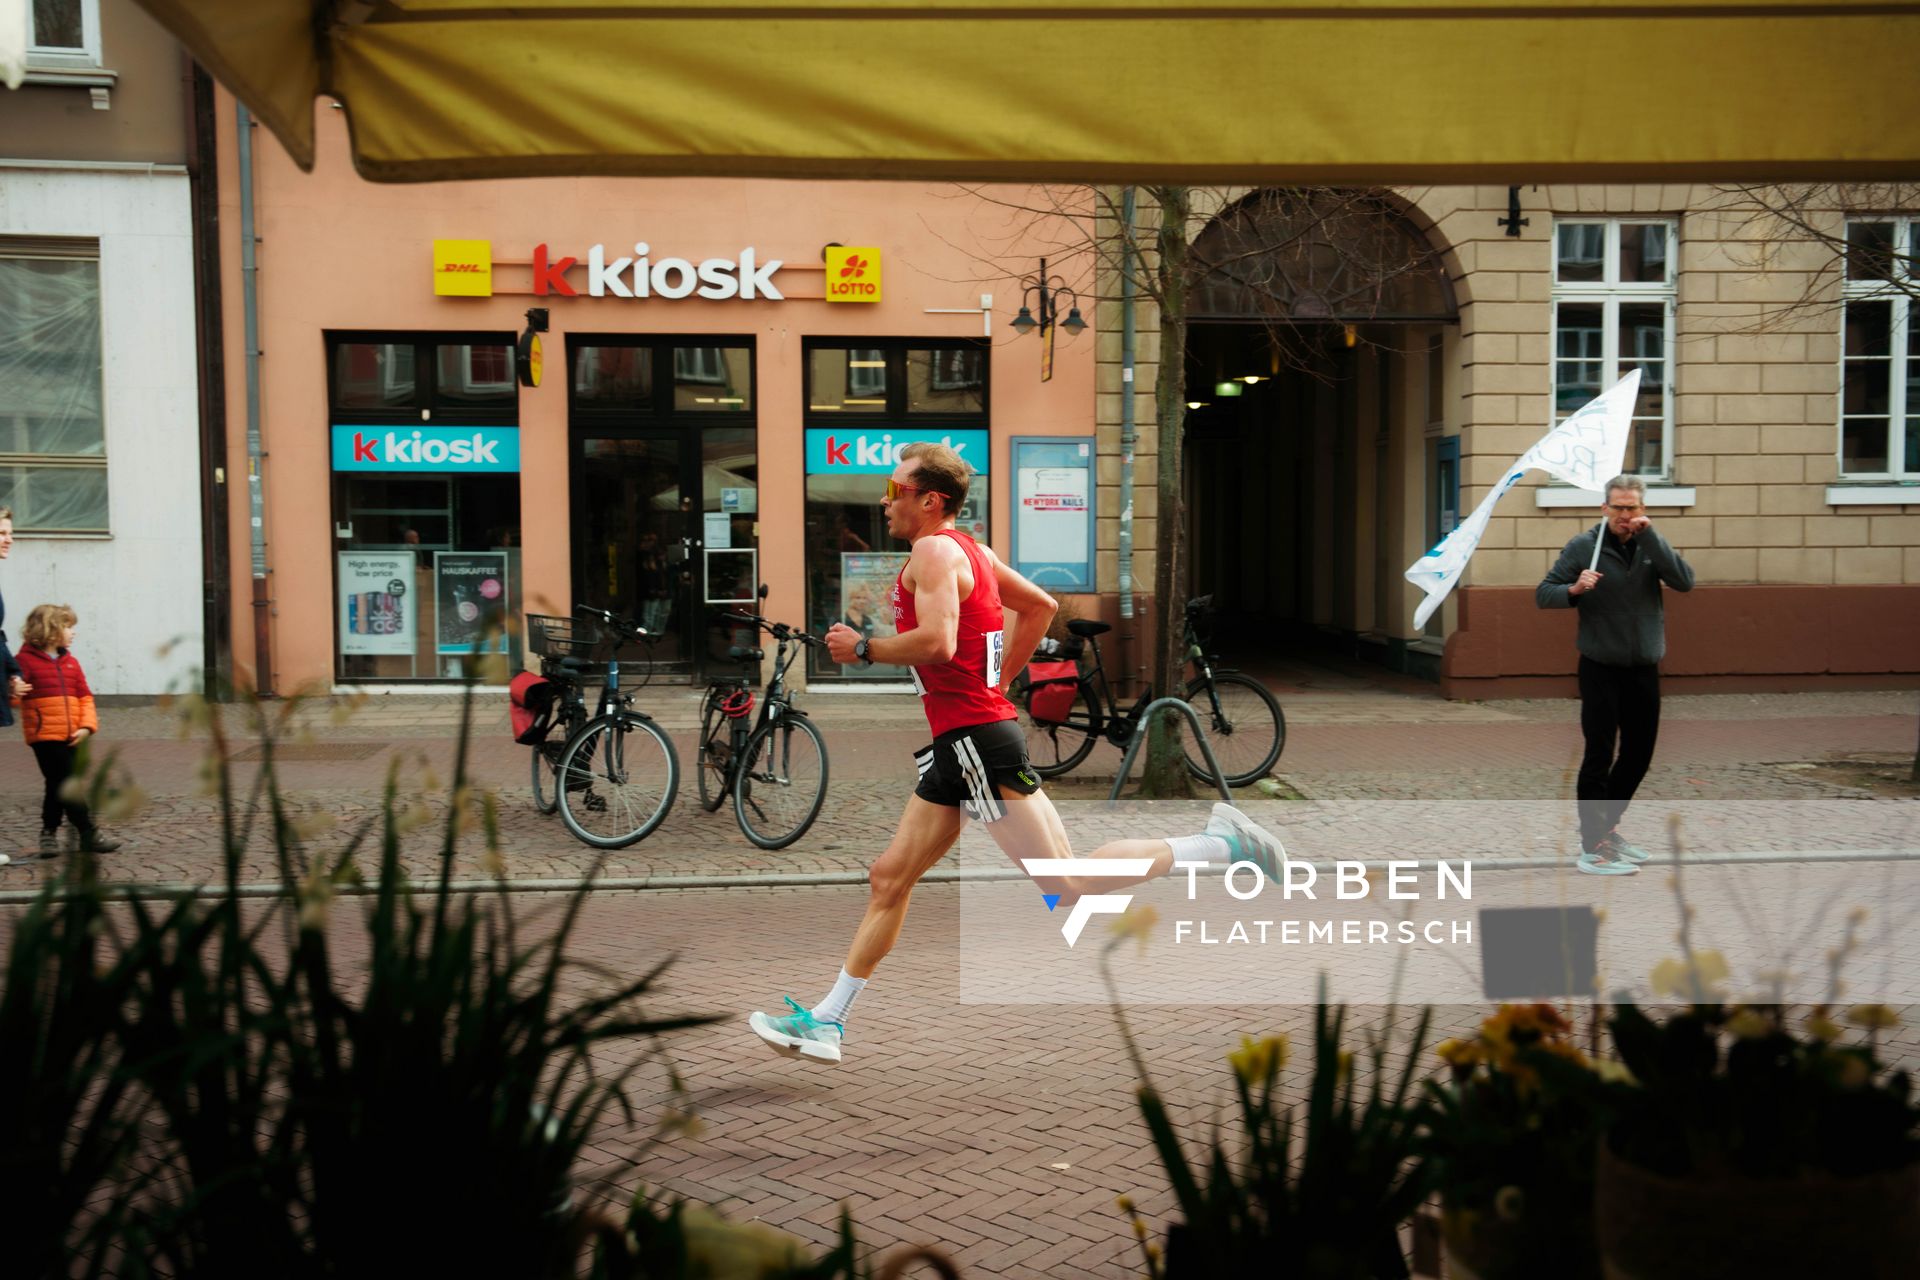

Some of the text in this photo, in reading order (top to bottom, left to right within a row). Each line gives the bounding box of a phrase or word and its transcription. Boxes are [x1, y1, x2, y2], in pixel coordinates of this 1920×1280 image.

[444, 263, 480, 273] DHL
[533, 242, 785, 300] k kiosk
[831, 282, 876, 295] LOTTO
[353, 431, 499, 464] k kiosk
[826, 436, 851, 465] k
[1062, 498, 1085, 506] NAILS
[348, 561, 368, 569] High
[372, 570, 394, 579] price
[441, 567, 498, 575] HAUSKAFFEE
